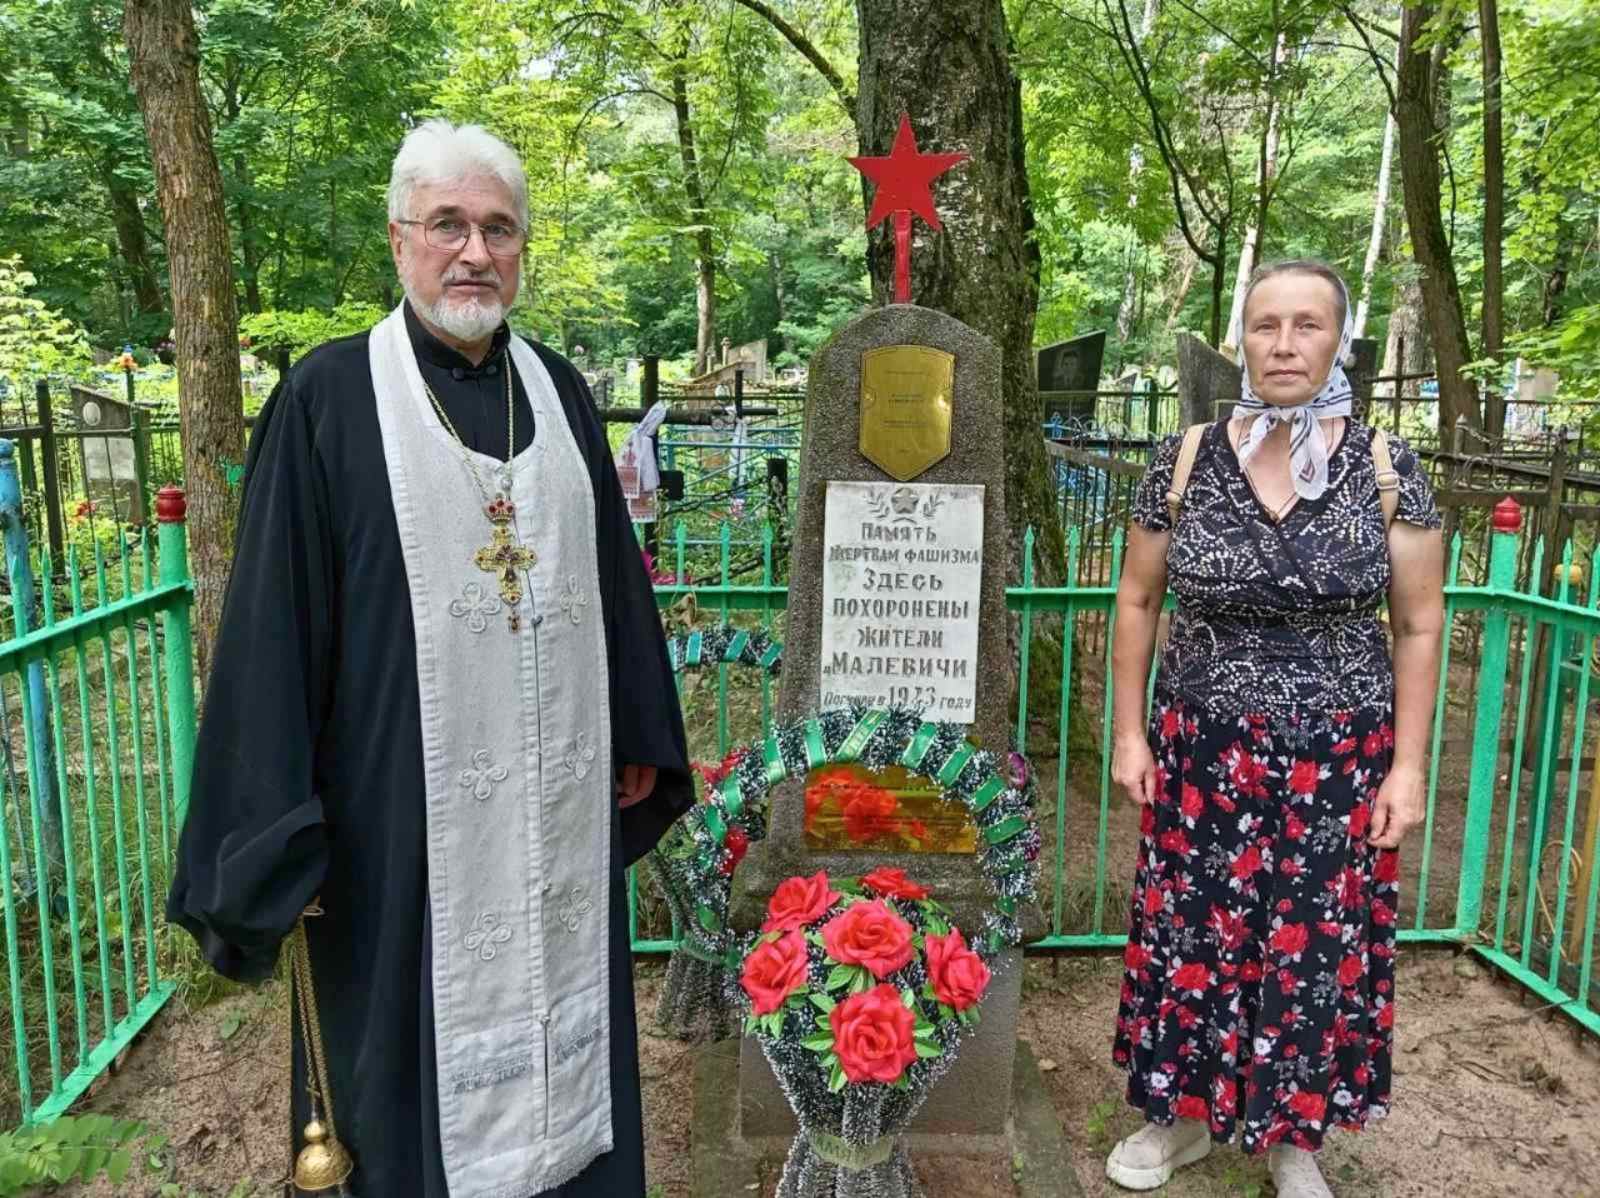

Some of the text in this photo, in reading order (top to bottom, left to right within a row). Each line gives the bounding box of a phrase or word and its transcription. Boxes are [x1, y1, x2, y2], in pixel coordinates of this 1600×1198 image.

[862, 523, 937, 543] ПАМЯТЬ
[828, 545, 979, 564] ЖЕРТВАМ ФАШИЗМА
[863, 567, 943, 592] ЗДЕСЬ
[833, 598, 969, 619] ПОХОРОНЕНЫ
[857, 626, 943, 648] ЖИТЕЛИ
